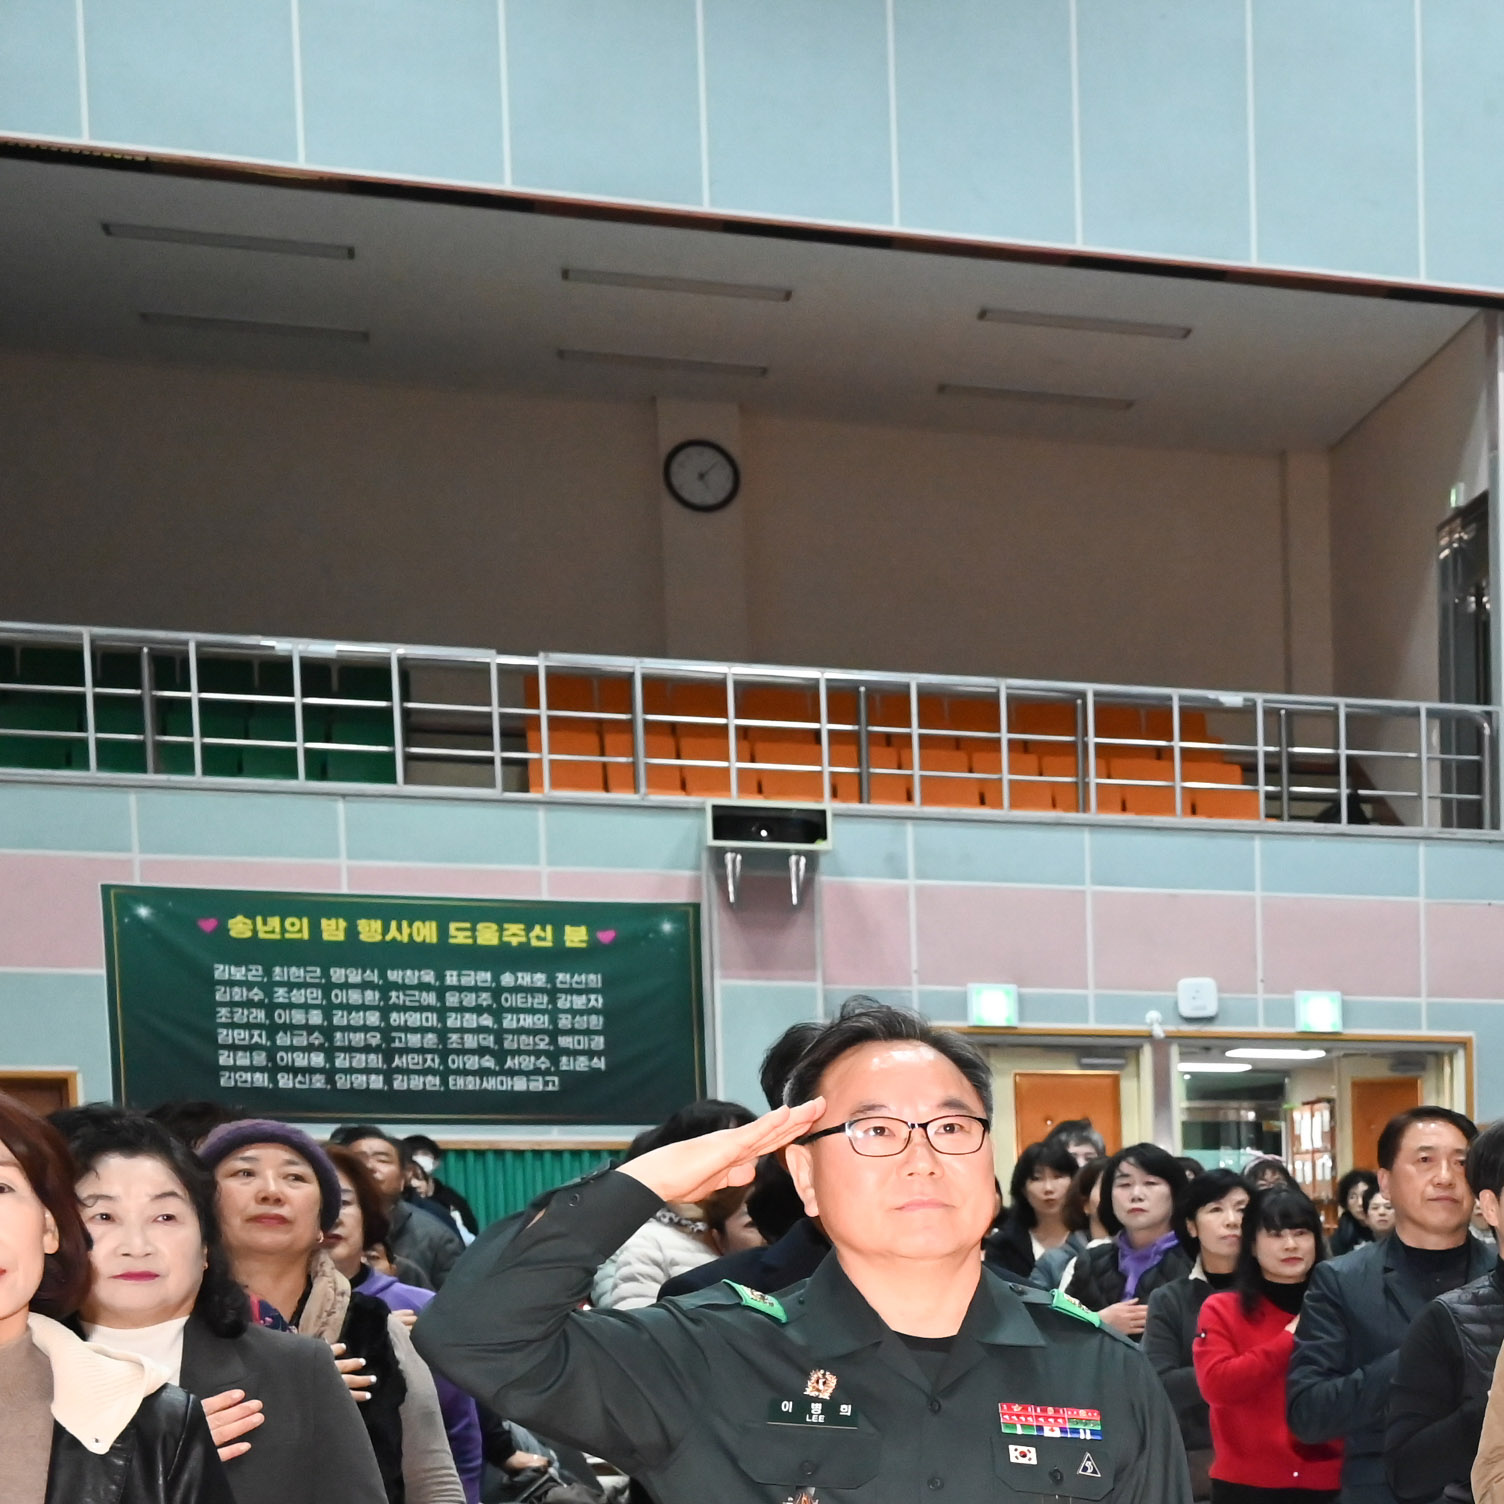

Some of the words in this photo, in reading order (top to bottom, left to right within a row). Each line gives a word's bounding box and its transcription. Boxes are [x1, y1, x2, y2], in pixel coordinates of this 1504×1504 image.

[228, 916, 309, 939] 송년의
[321, 919, 346, 940] 밤
[358, 919, 437, 943] 행사에
[449, 922, 552, 946] 도움주신
[564, 925, 588, 947] 분
[806, 1414, 825, 1423] LEE
